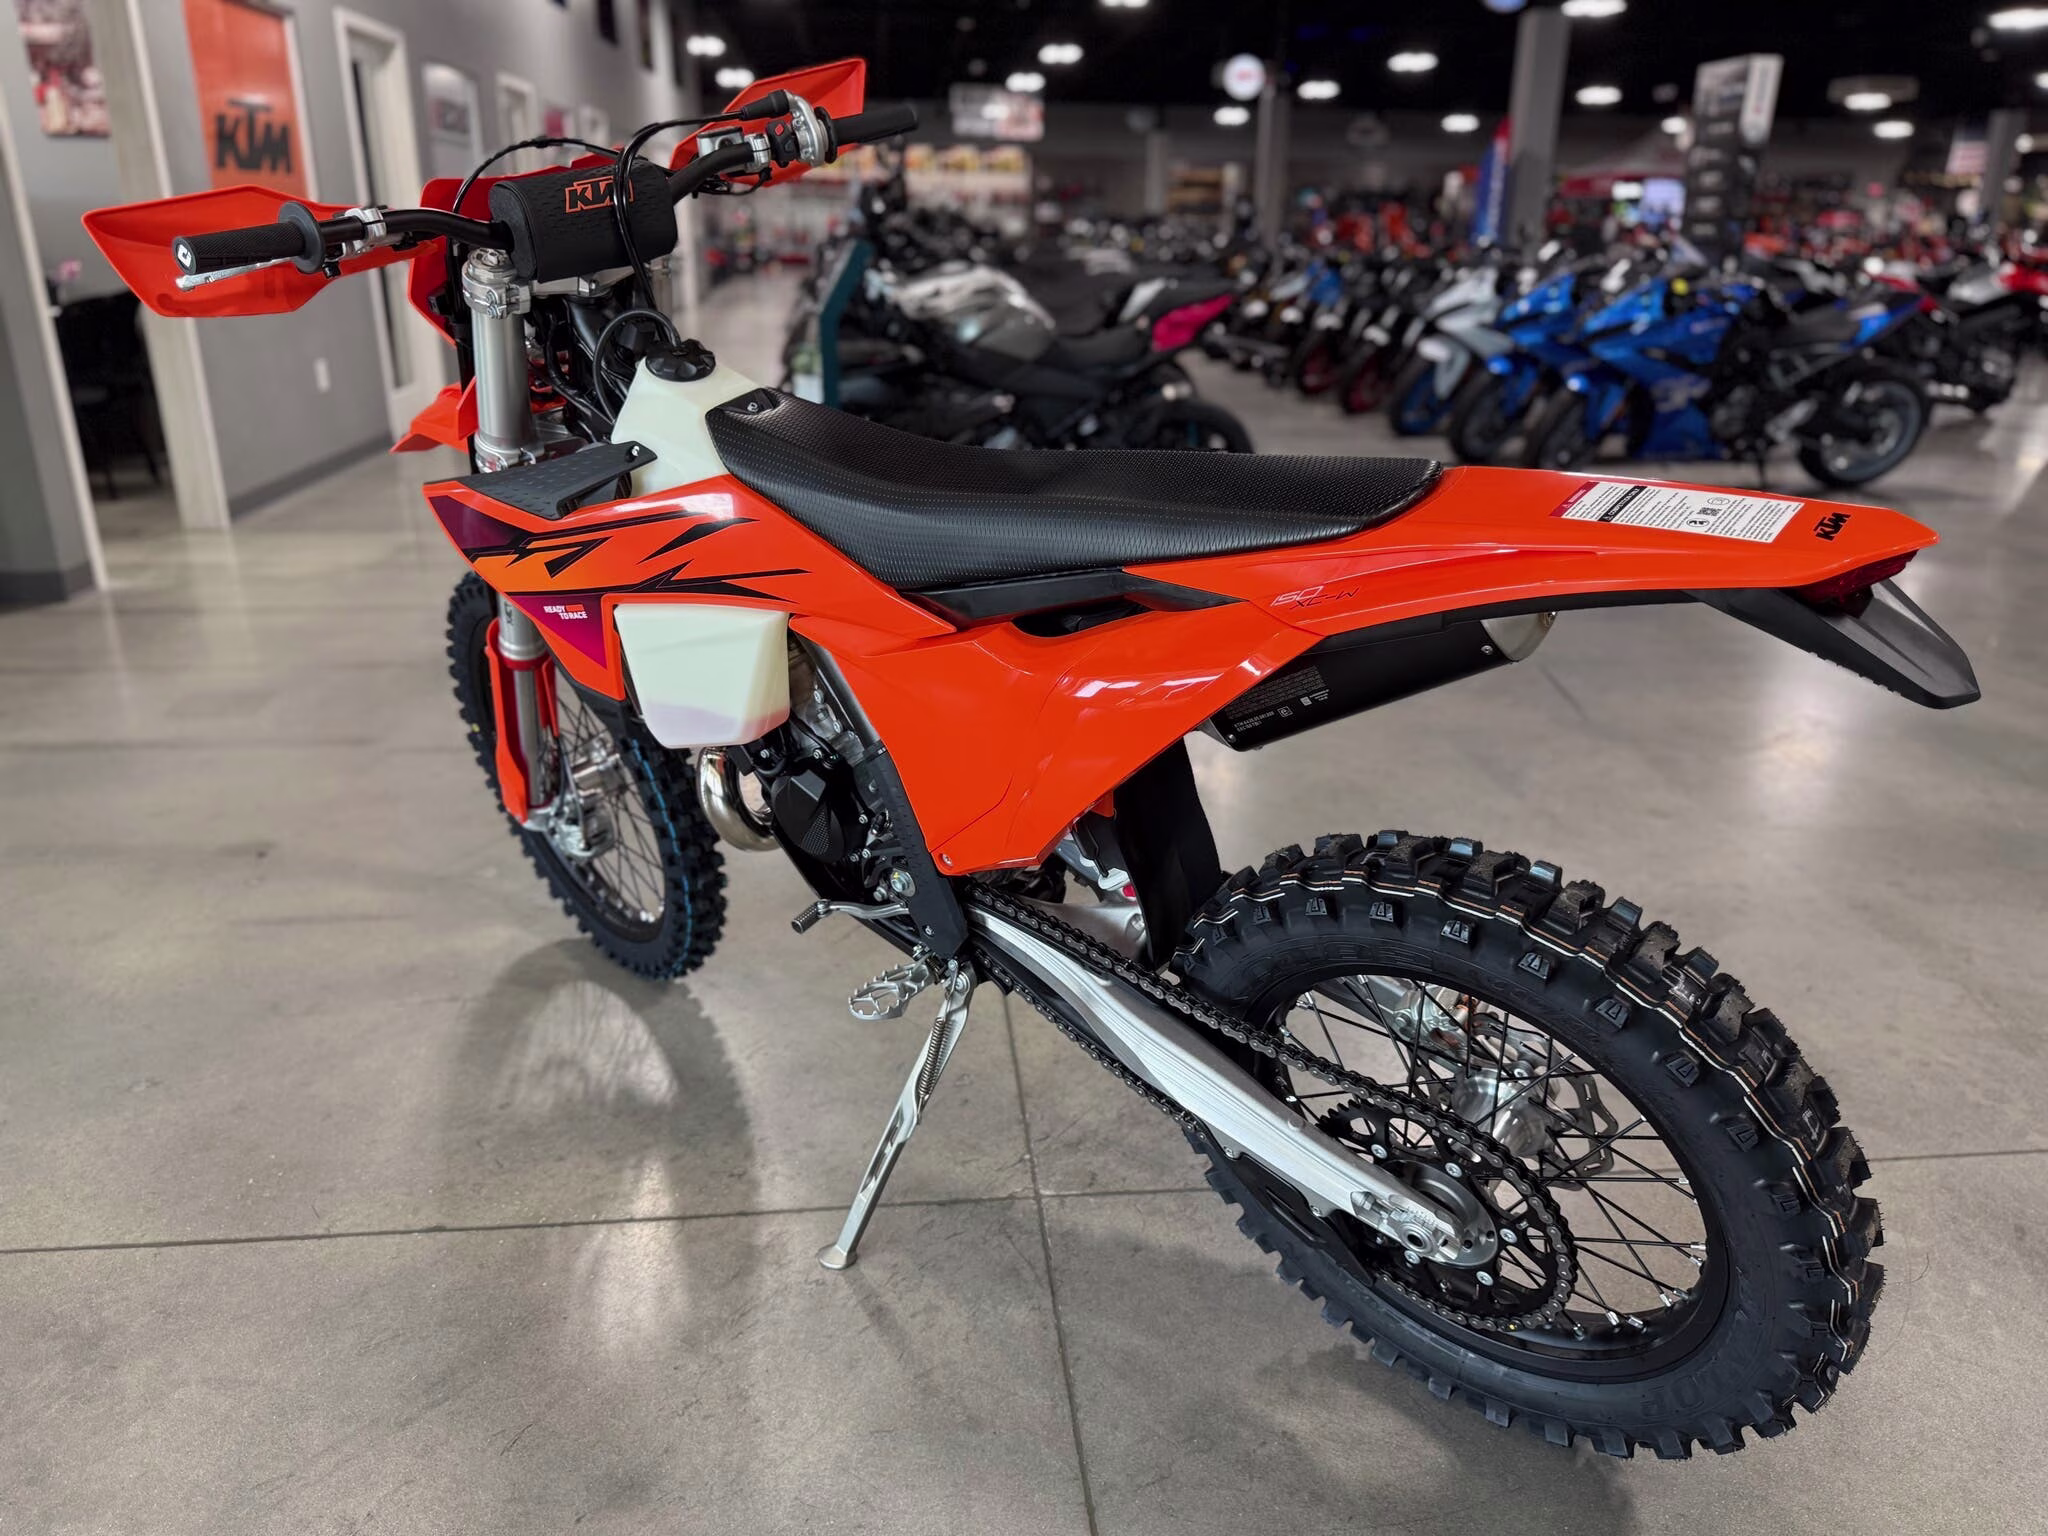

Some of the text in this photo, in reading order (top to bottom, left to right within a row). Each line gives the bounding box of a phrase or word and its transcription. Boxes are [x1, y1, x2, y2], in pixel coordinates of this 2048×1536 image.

[215, 98, 293, 175] KTM
[1813, 512, 1851, 541] KTM
[543, 605, 565, 613] READY
